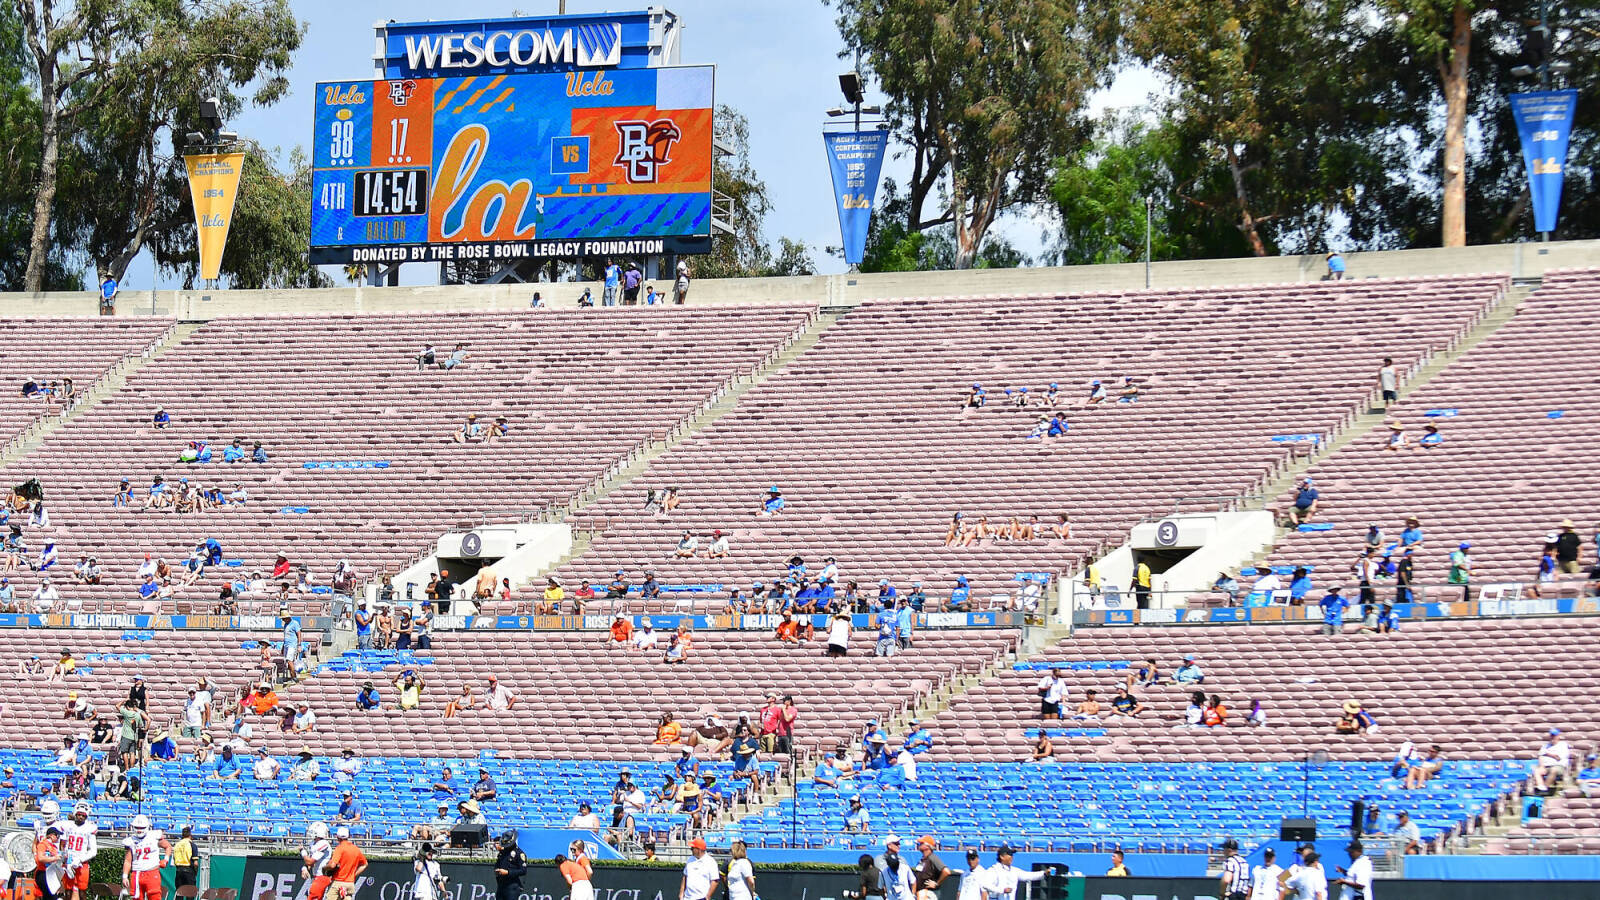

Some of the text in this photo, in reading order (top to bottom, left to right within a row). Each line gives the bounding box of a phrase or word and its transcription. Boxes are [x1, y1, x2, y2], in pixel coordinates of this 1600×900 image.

[404, 28, 574, 70] WESCOM
[565, 71, 614, 98] Ucla
[325, 85, 365, 105] Ucla
[330, 118, 408, 158] 38 17
[562, 145, 580, 164] VS
[321, 171, 418, 214] 4TH 14:54
[353, 240, 664, 261] DONATED BY THE ROSE BOWL LEGACY FOUNDATION
[1163, 526, 1173, 540] 3
[467, 537, 476, 551] 4
[97, 614, 136, 627] FOOTBALL
[585, 616, 609, 628] ROSE
